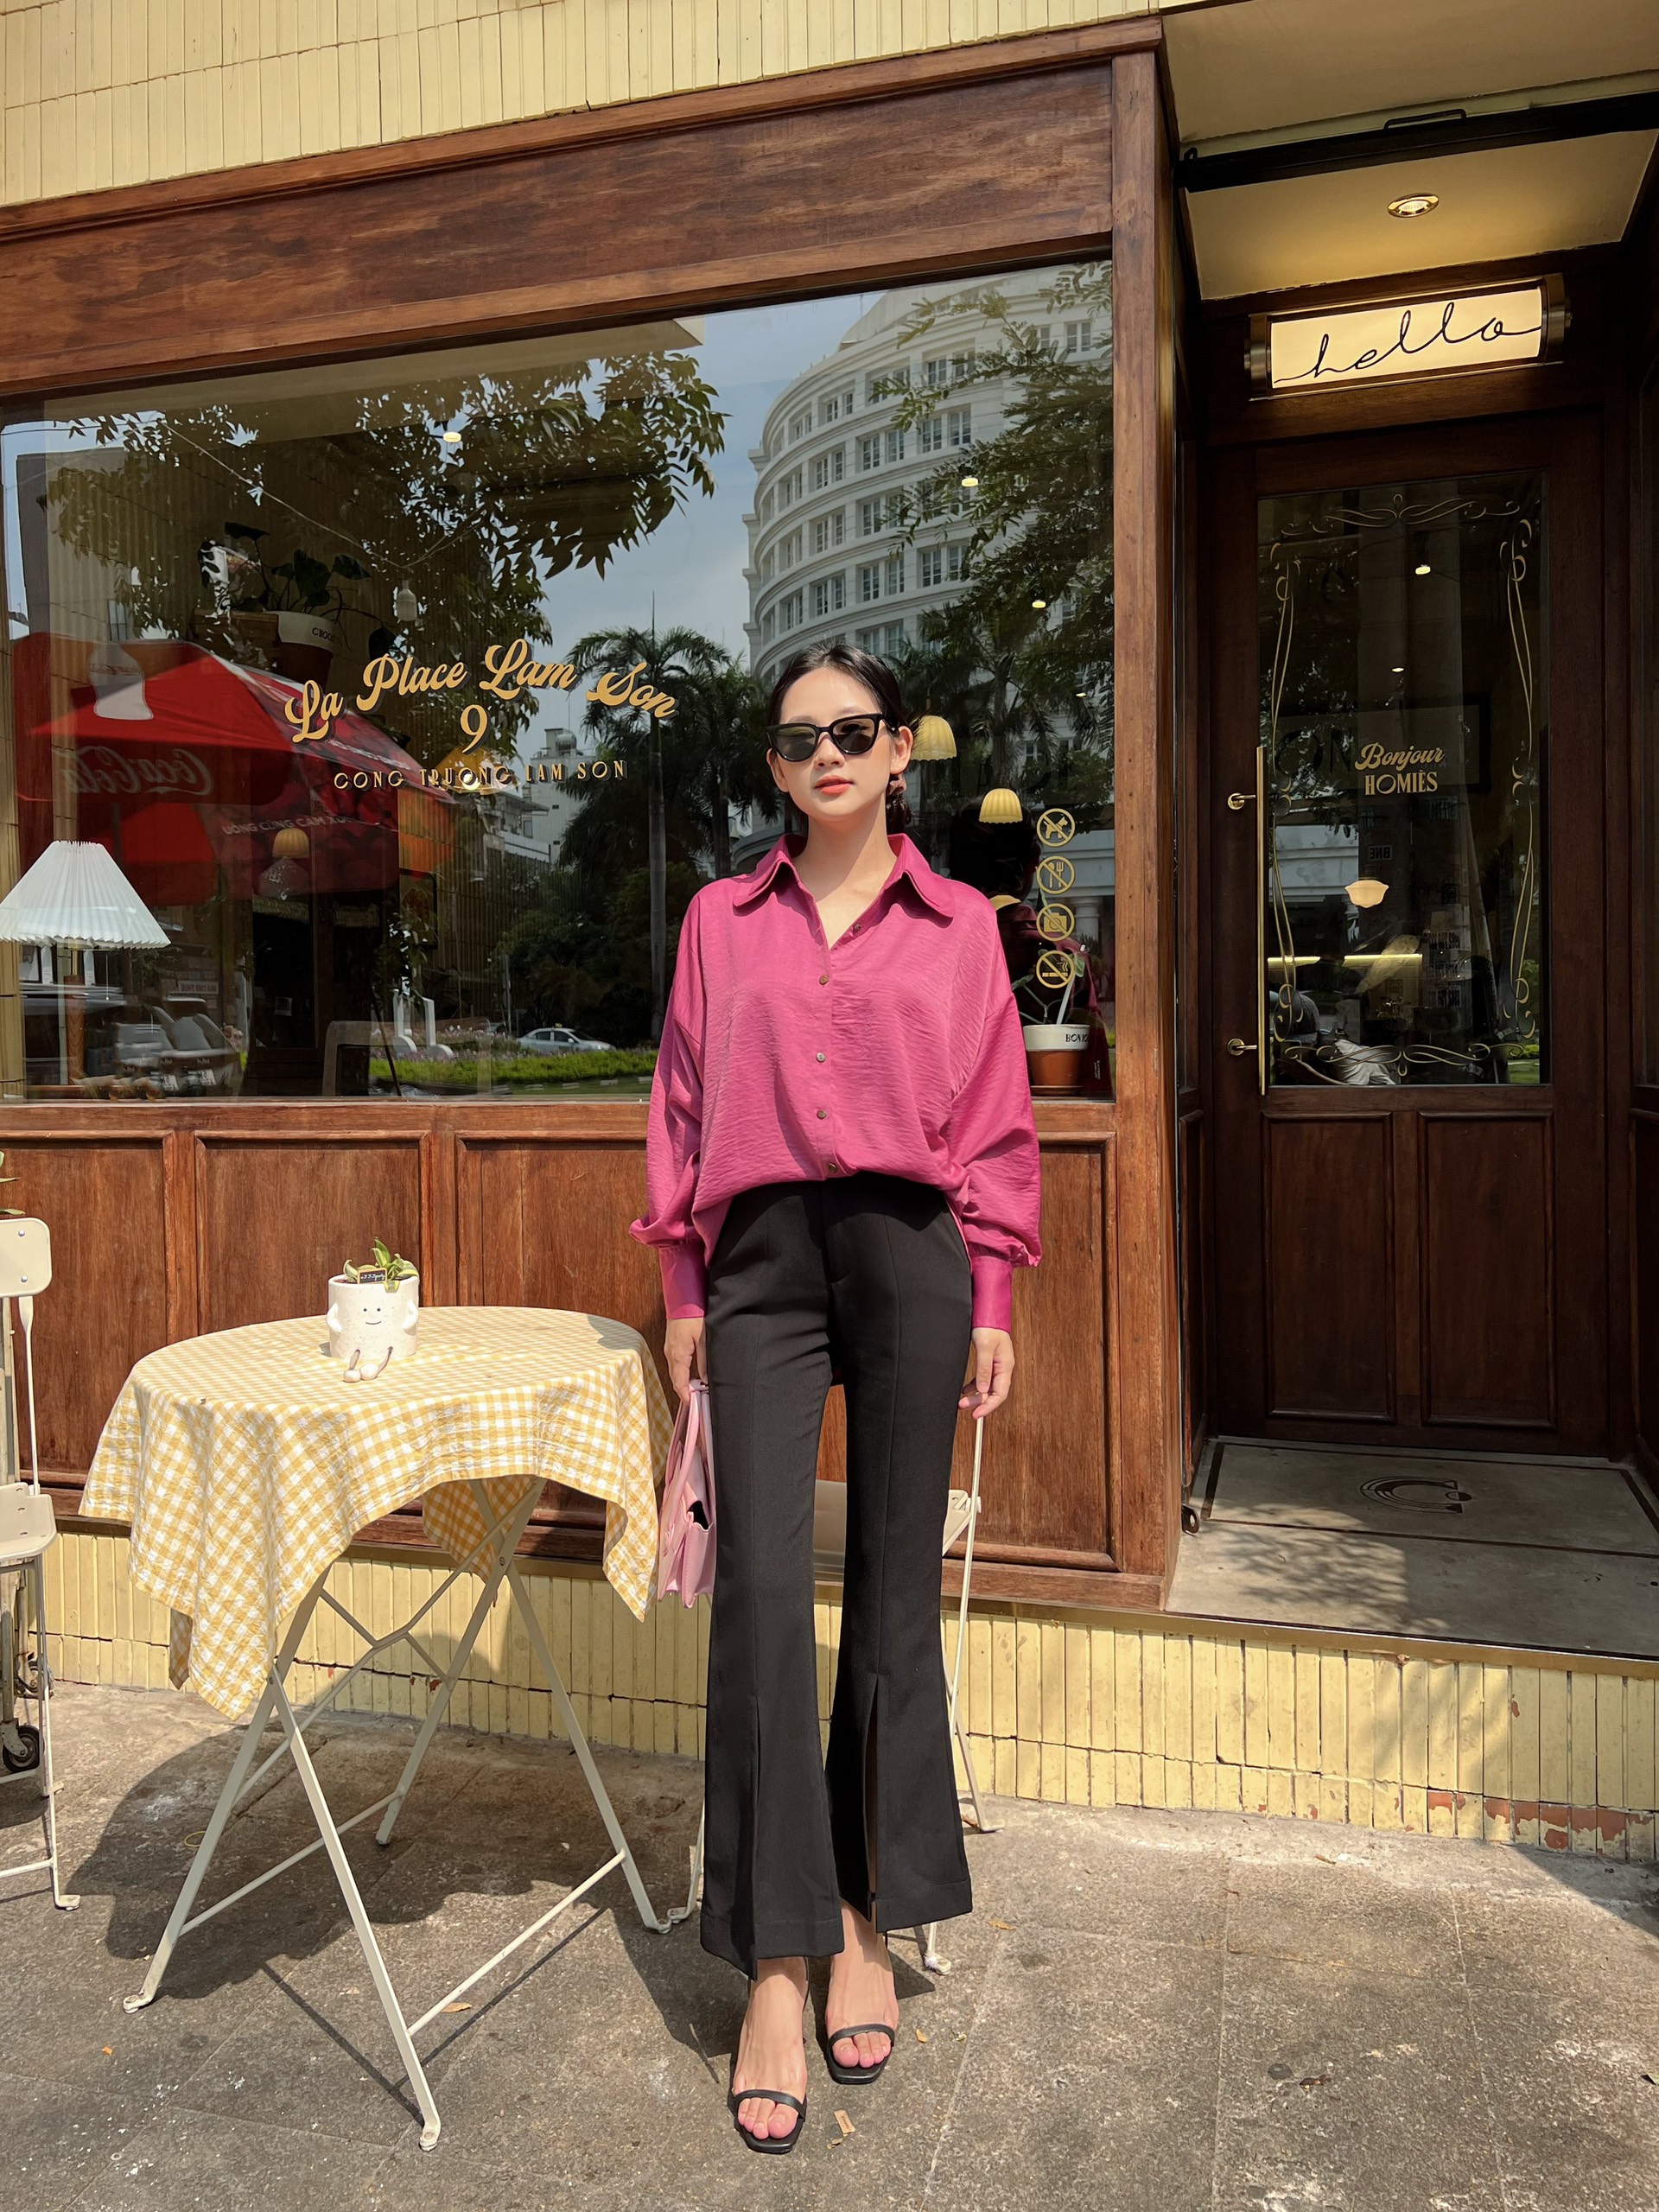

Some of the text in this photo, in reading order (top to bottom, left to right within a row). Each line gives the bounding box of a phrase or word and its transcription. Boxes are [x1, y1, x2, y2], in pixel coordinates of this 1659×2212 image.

[1274, 302, 1541, 383] hello
[284, 639, 678, 743] La Place Lam Son
[460, 704, 489, 755] 9
[334, 760, 626, 790] CONG TRUONG LAM SON
[1355, 742, 1446, 771] Bonjour
